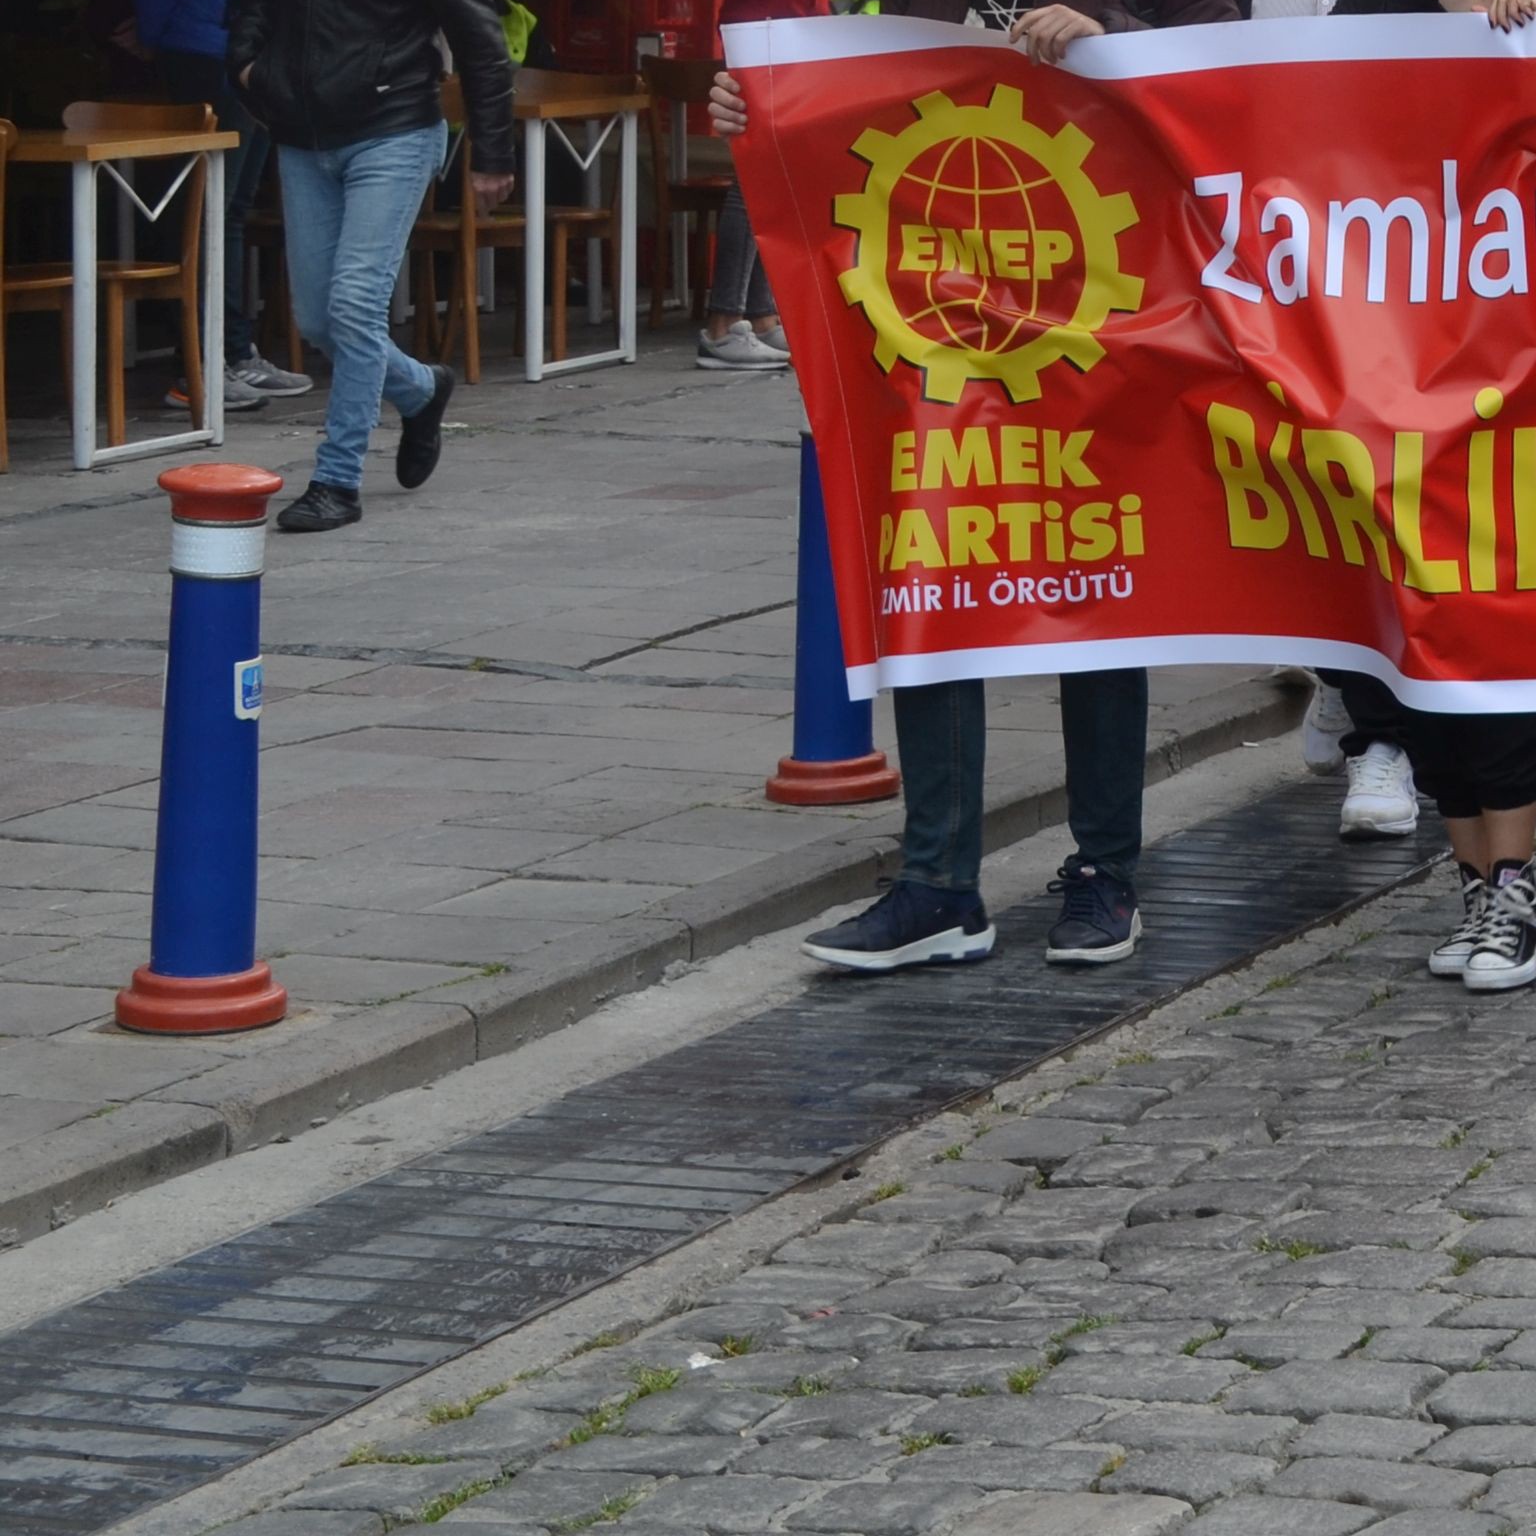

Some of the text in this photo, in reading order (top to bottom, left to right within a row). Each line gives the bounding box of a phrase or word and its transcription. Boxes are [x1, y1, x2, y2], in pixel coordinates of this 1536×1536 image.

[897, 223, 1074, 281] EMEP
[890, 424, 1102, 493] EMEK
[878, 493, 1145, 574] PARTİSİ
[880, 564, 1134, 616] ZMİR İL ÖRGÜTÜ
